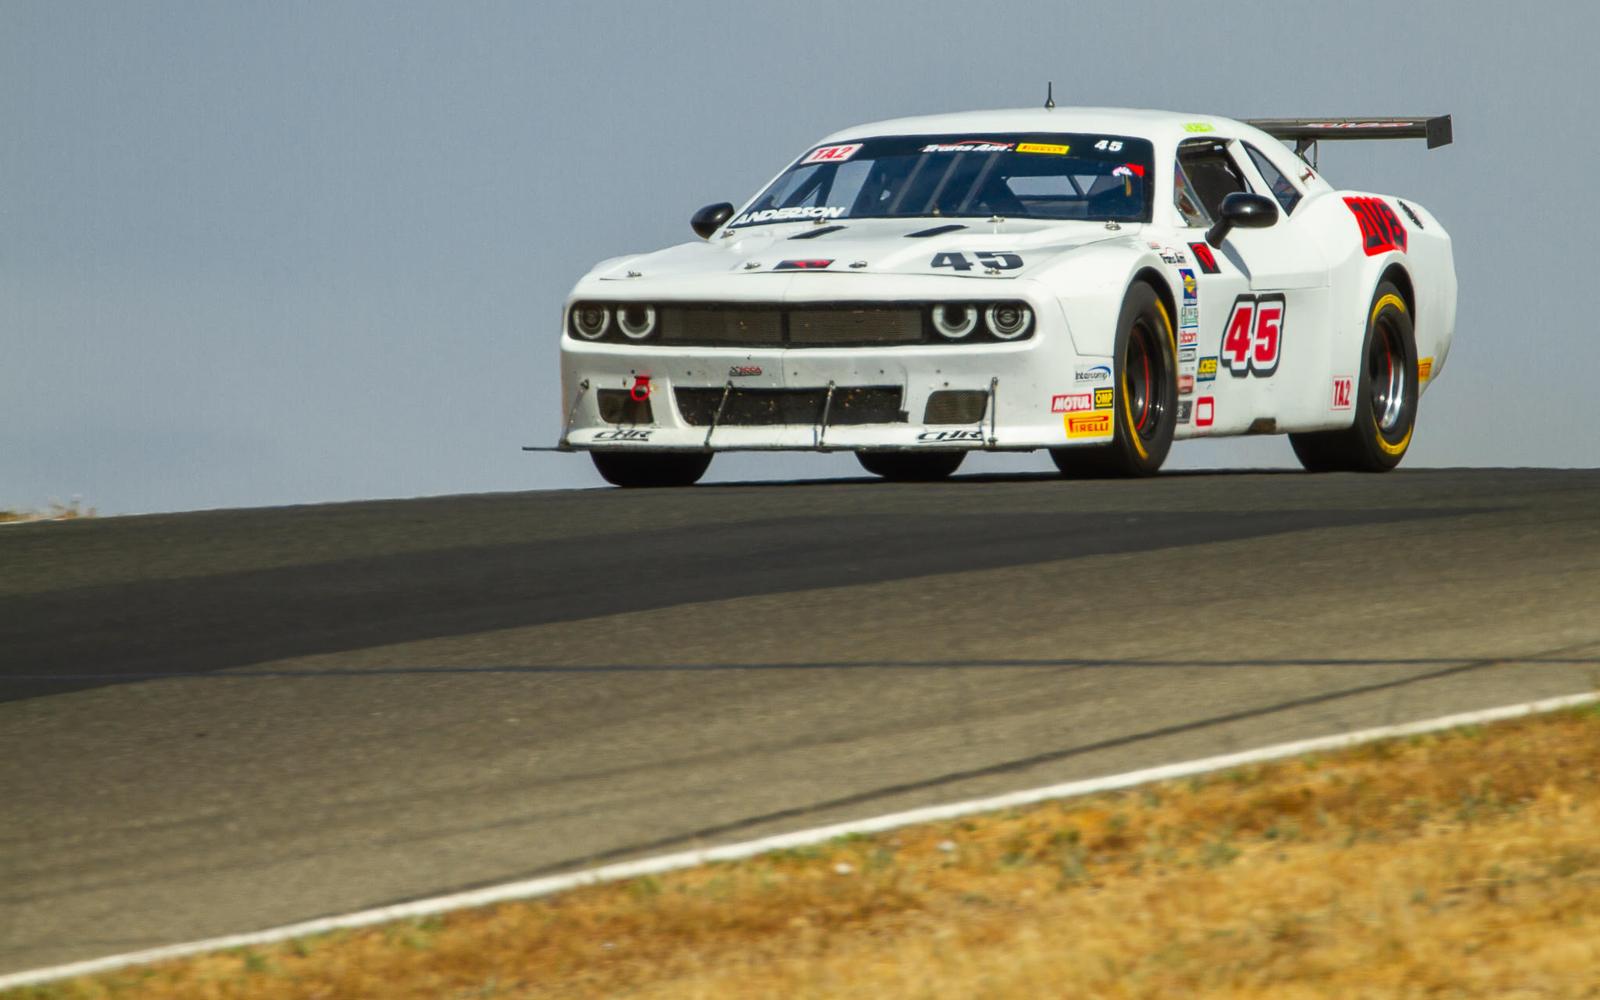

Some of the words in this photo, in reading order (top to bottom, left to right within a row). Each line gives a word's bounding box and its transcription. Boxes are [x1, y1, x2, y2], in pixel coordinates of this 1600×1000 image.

[812, 147, 852, 160] TA2
[1094, 140, 1122, 151] 45
[731, 207, 845, 225] ANDERSON
[931, 252, 1023, 271] 45
[1222, 301, 1283, 370] 45
[1095, 393, 1112, 404] OMP
[1334, 380, 1350, 406] TA2
[1053, 395, 1090, 410] MOTUL
[1068, 416, 1108, 433] PIRELLI
